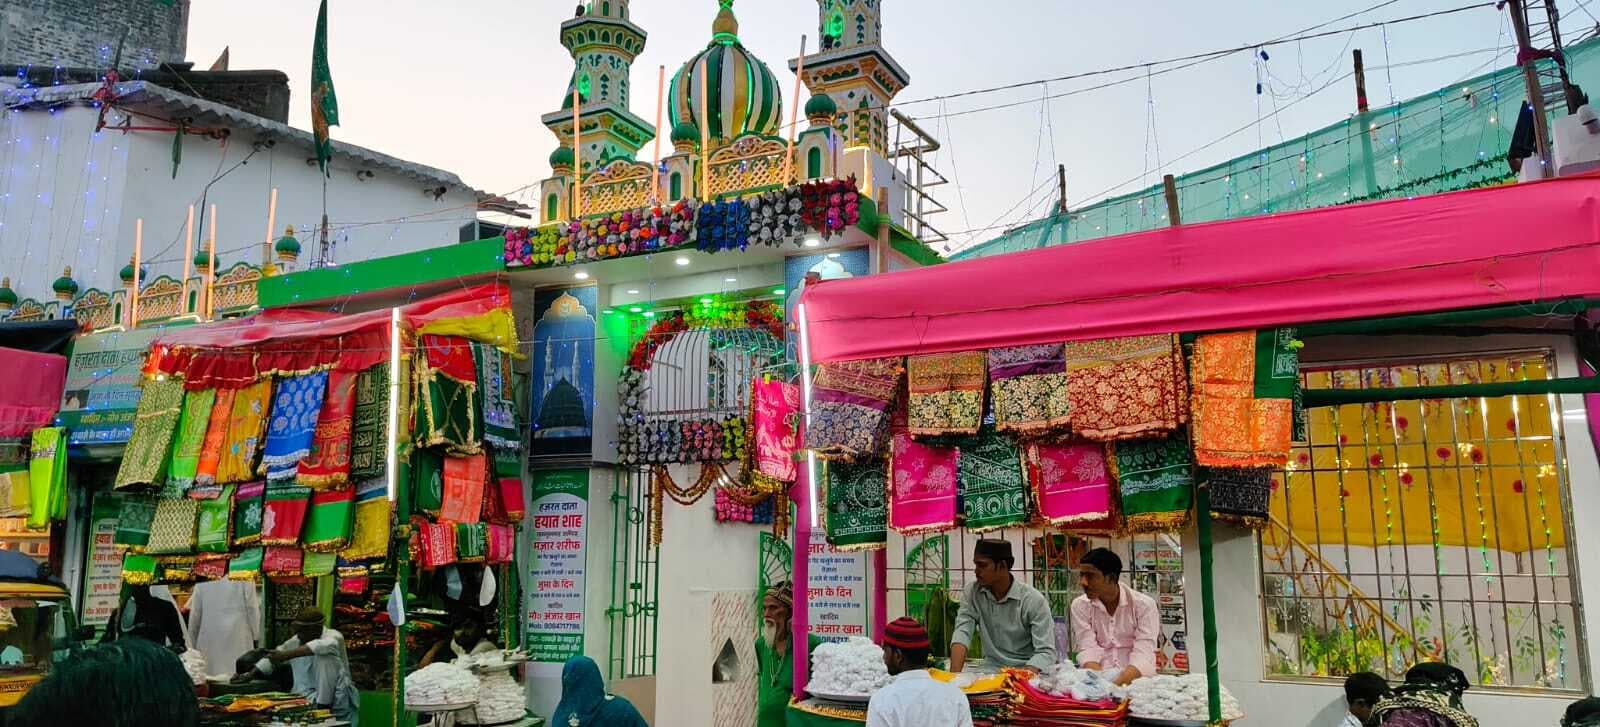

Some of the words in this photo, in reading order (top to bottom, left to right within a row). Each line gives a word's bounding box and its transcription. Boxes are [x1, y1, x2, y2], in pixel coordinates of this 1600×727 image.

[534, 515, 560, 528] हयात
[562, 515, 583, 528] शाह
[556, 538, 581, 551] शरीफ
[537, 580, 551, 591] जुमा
[552, 580, 560, 588] के
[561, 579, 574, 588] दिन
[825, 586, 834, 596] के
[836, 586, 852, 596] दिन
[565, 612, 581, 620] खान
[816, 622, 840, 634] अंजार
[842, 624, 864, 634] खान
